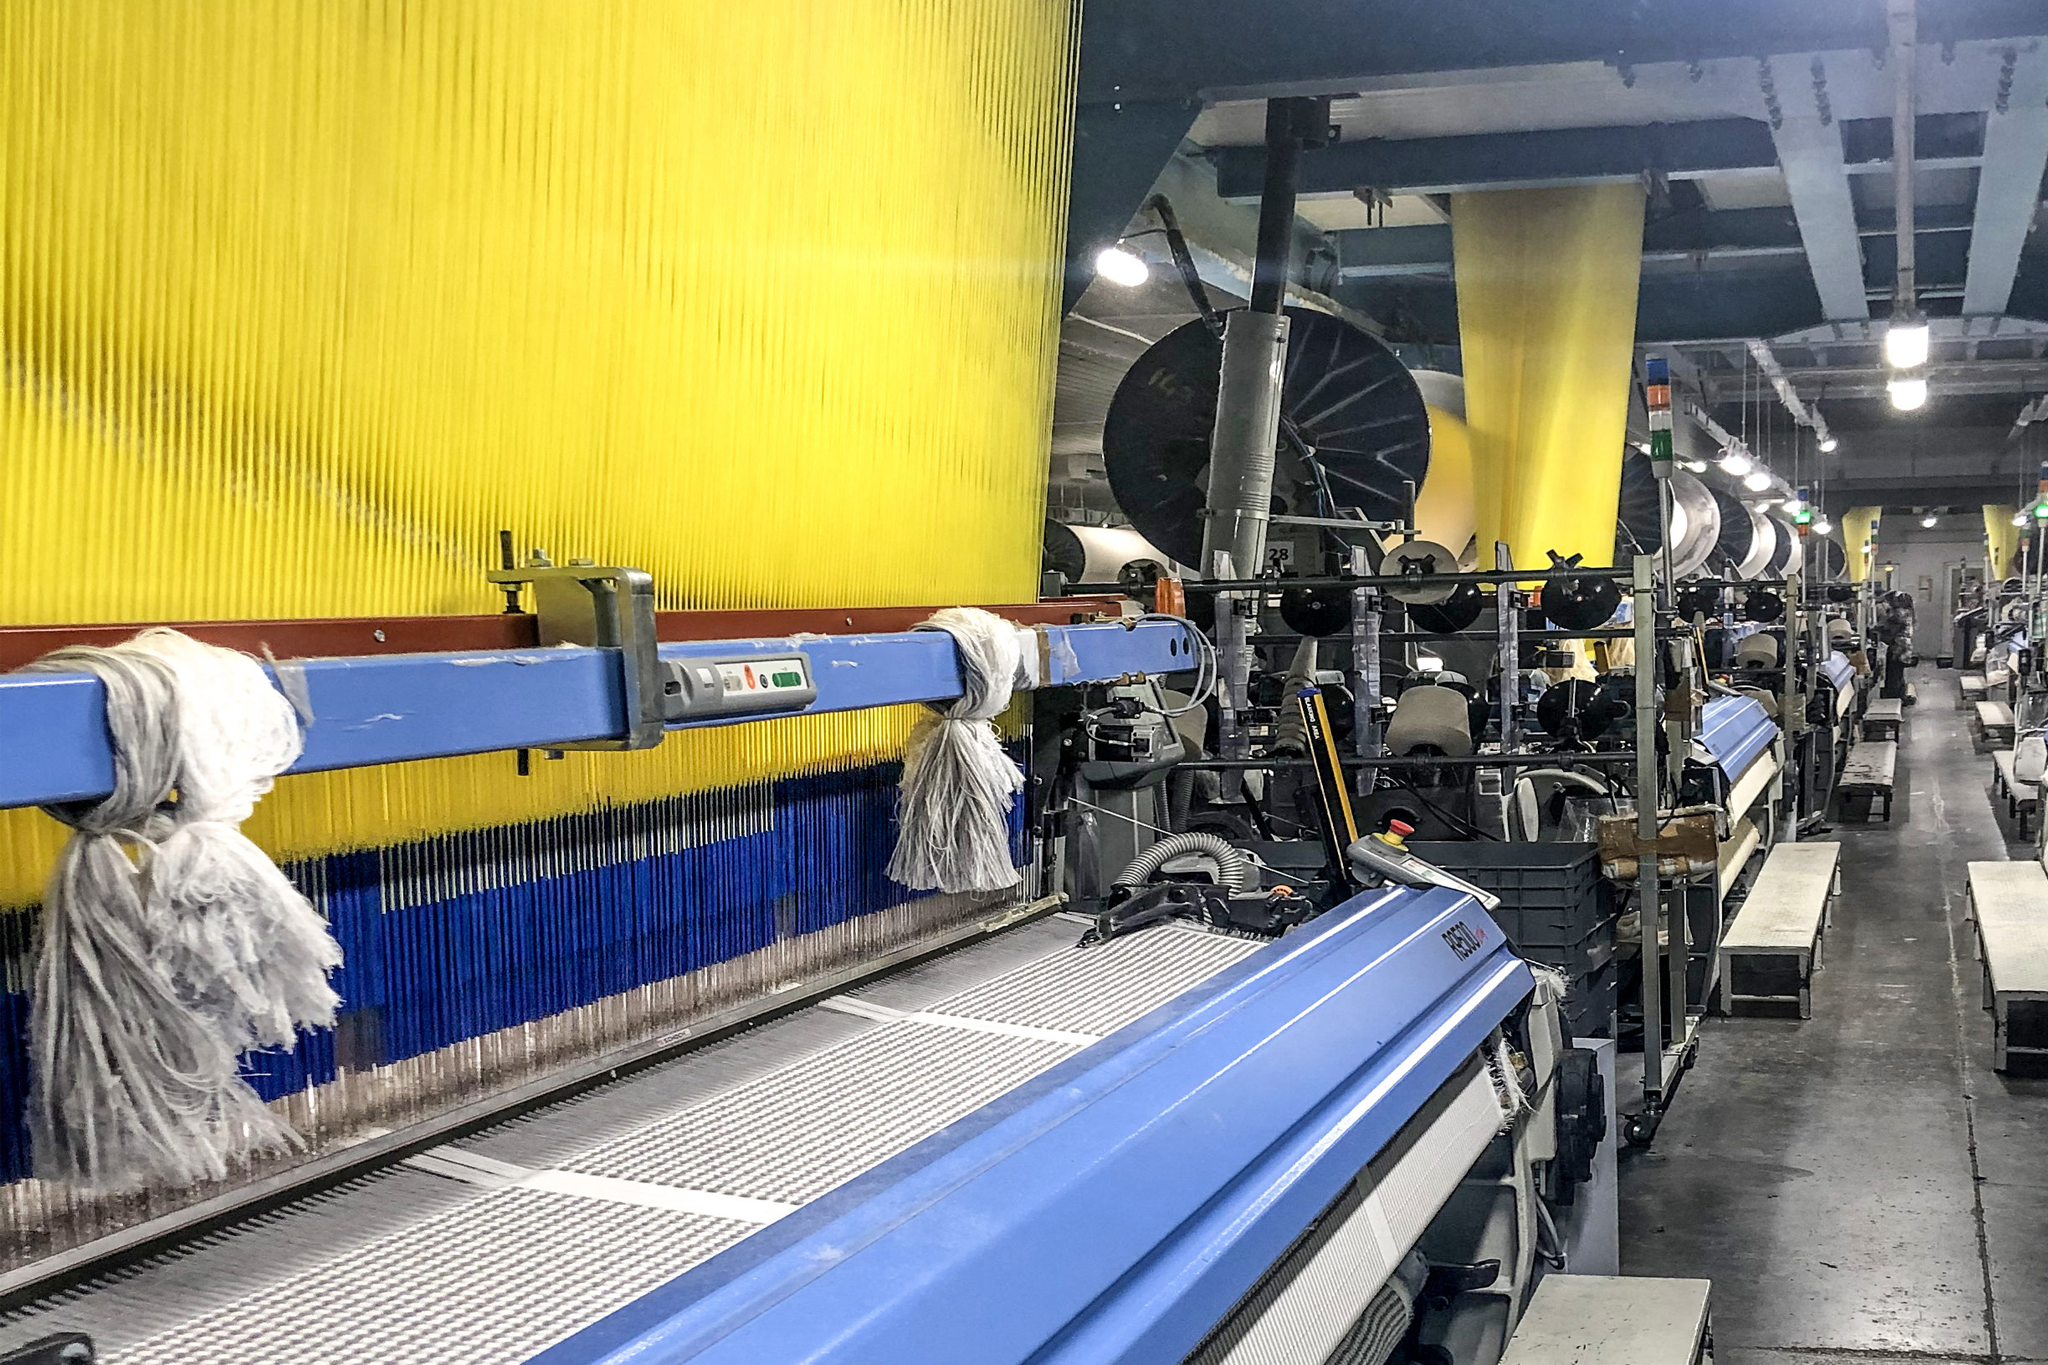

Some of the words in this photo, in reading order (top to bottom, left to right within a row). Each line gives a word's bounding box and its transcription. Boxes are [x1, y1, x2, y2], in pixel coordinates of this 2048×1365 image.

[1269, 548, 1289, 561] 28
[1311, 725, 1320, 740] AREA
[1441, 920, 1481, 961] R9500
